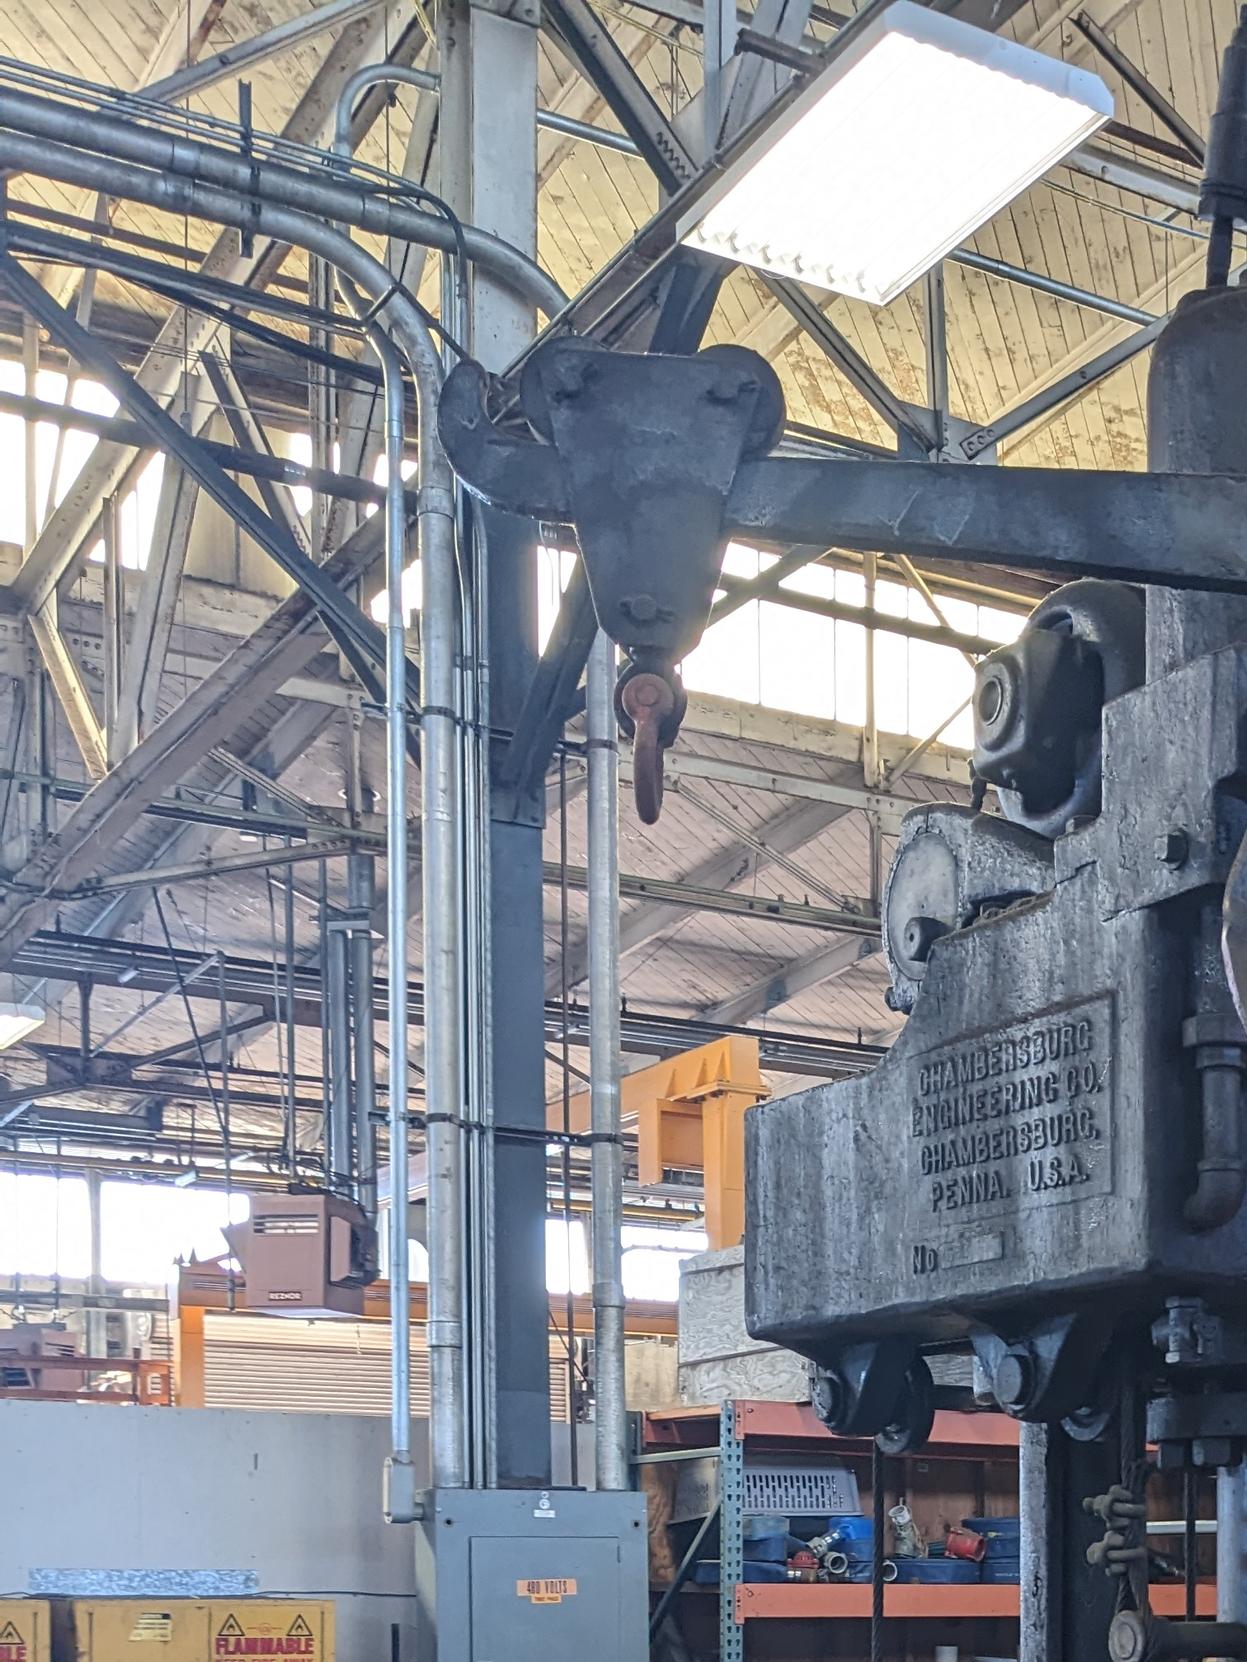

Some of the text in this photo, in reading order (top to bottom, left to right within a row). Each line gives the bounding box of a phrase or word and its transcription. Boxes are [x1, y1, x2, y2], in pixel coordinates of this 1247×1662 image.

[919, 1018, 1093, 1097] CHAMBERSBURG
[911, 1073, 1059, 1138] ENGINEERING
[921, 1107, 1100, 1176] CHAMBERSBURG,
[1028, 1155, 1091, 1192] U.S.A.
[269, 1292, 302, 1300] REZNOR
[544, 1580, 567, 1594] VOLTS
[215, 1637, 315, 1655] FLAMMABLE
